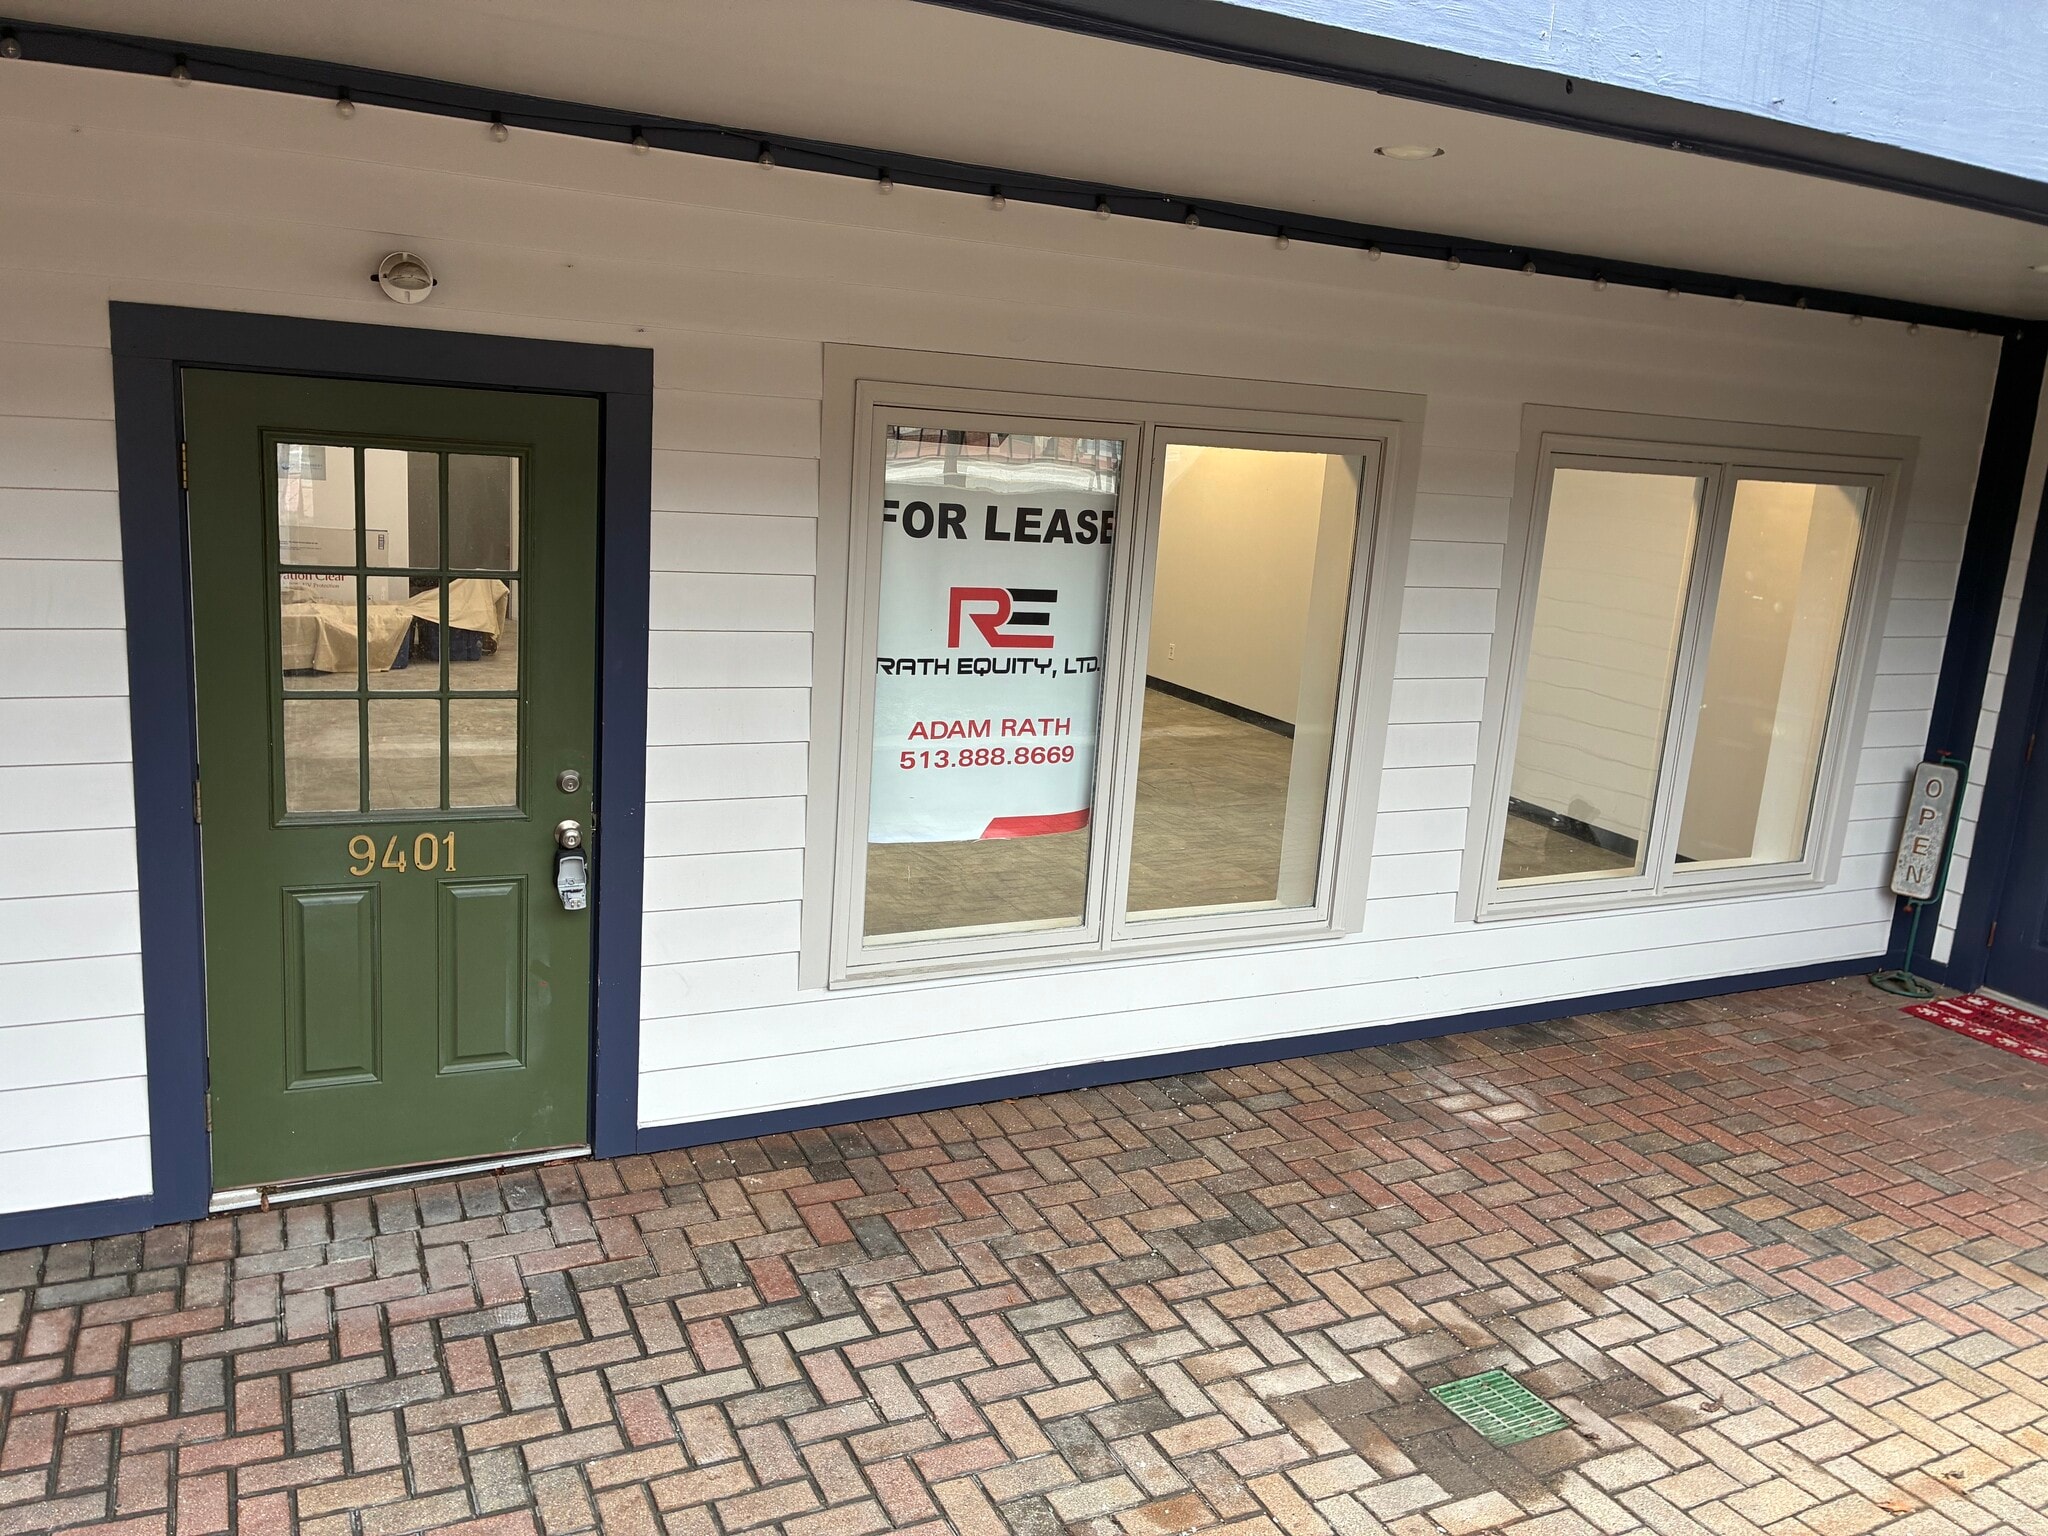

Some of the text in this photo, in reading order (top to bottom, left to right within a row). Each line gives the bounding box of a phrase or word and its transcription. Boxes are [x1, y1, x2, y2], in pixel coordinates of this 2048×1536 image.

[947, 587, 1058, 649] RE
[876, 656, 1101, 679] RATH EQUITY, LTD.
[908, 717, 1071, 740] ADAM RATH
[899, 745, 1075, 770] 513.888.8669
[1905, 780, 1942, 883] OPEN
[349, 831, 457, 877] 9401
